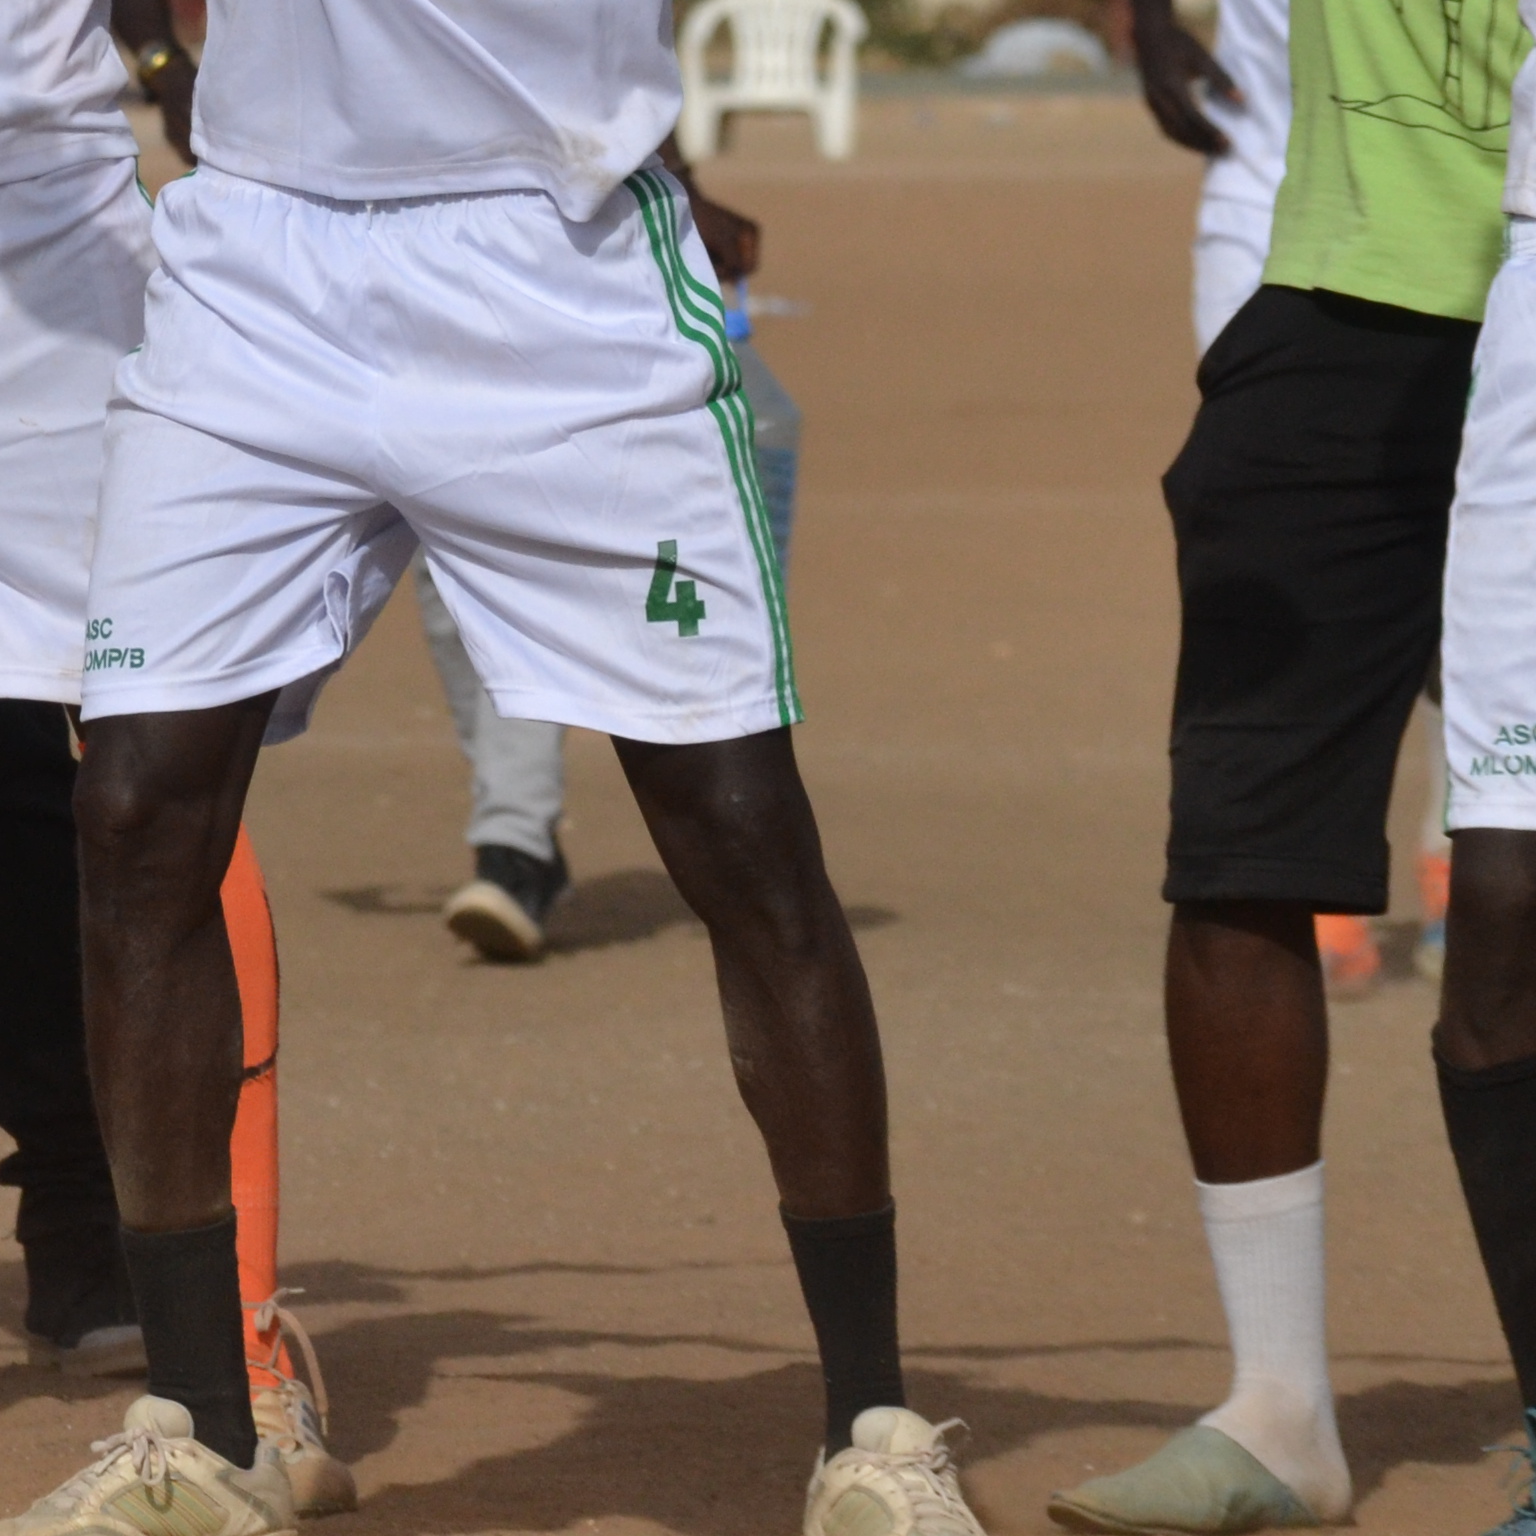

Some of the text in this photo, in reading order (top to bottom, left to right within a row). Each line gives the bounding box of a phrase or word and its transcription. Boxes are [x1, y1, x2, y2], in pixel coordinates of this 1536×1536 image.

[645, 539, 707, 637] 4
[83, 647, 145, 672] OMP/B
[1493, 724, 1536, 746] AS
